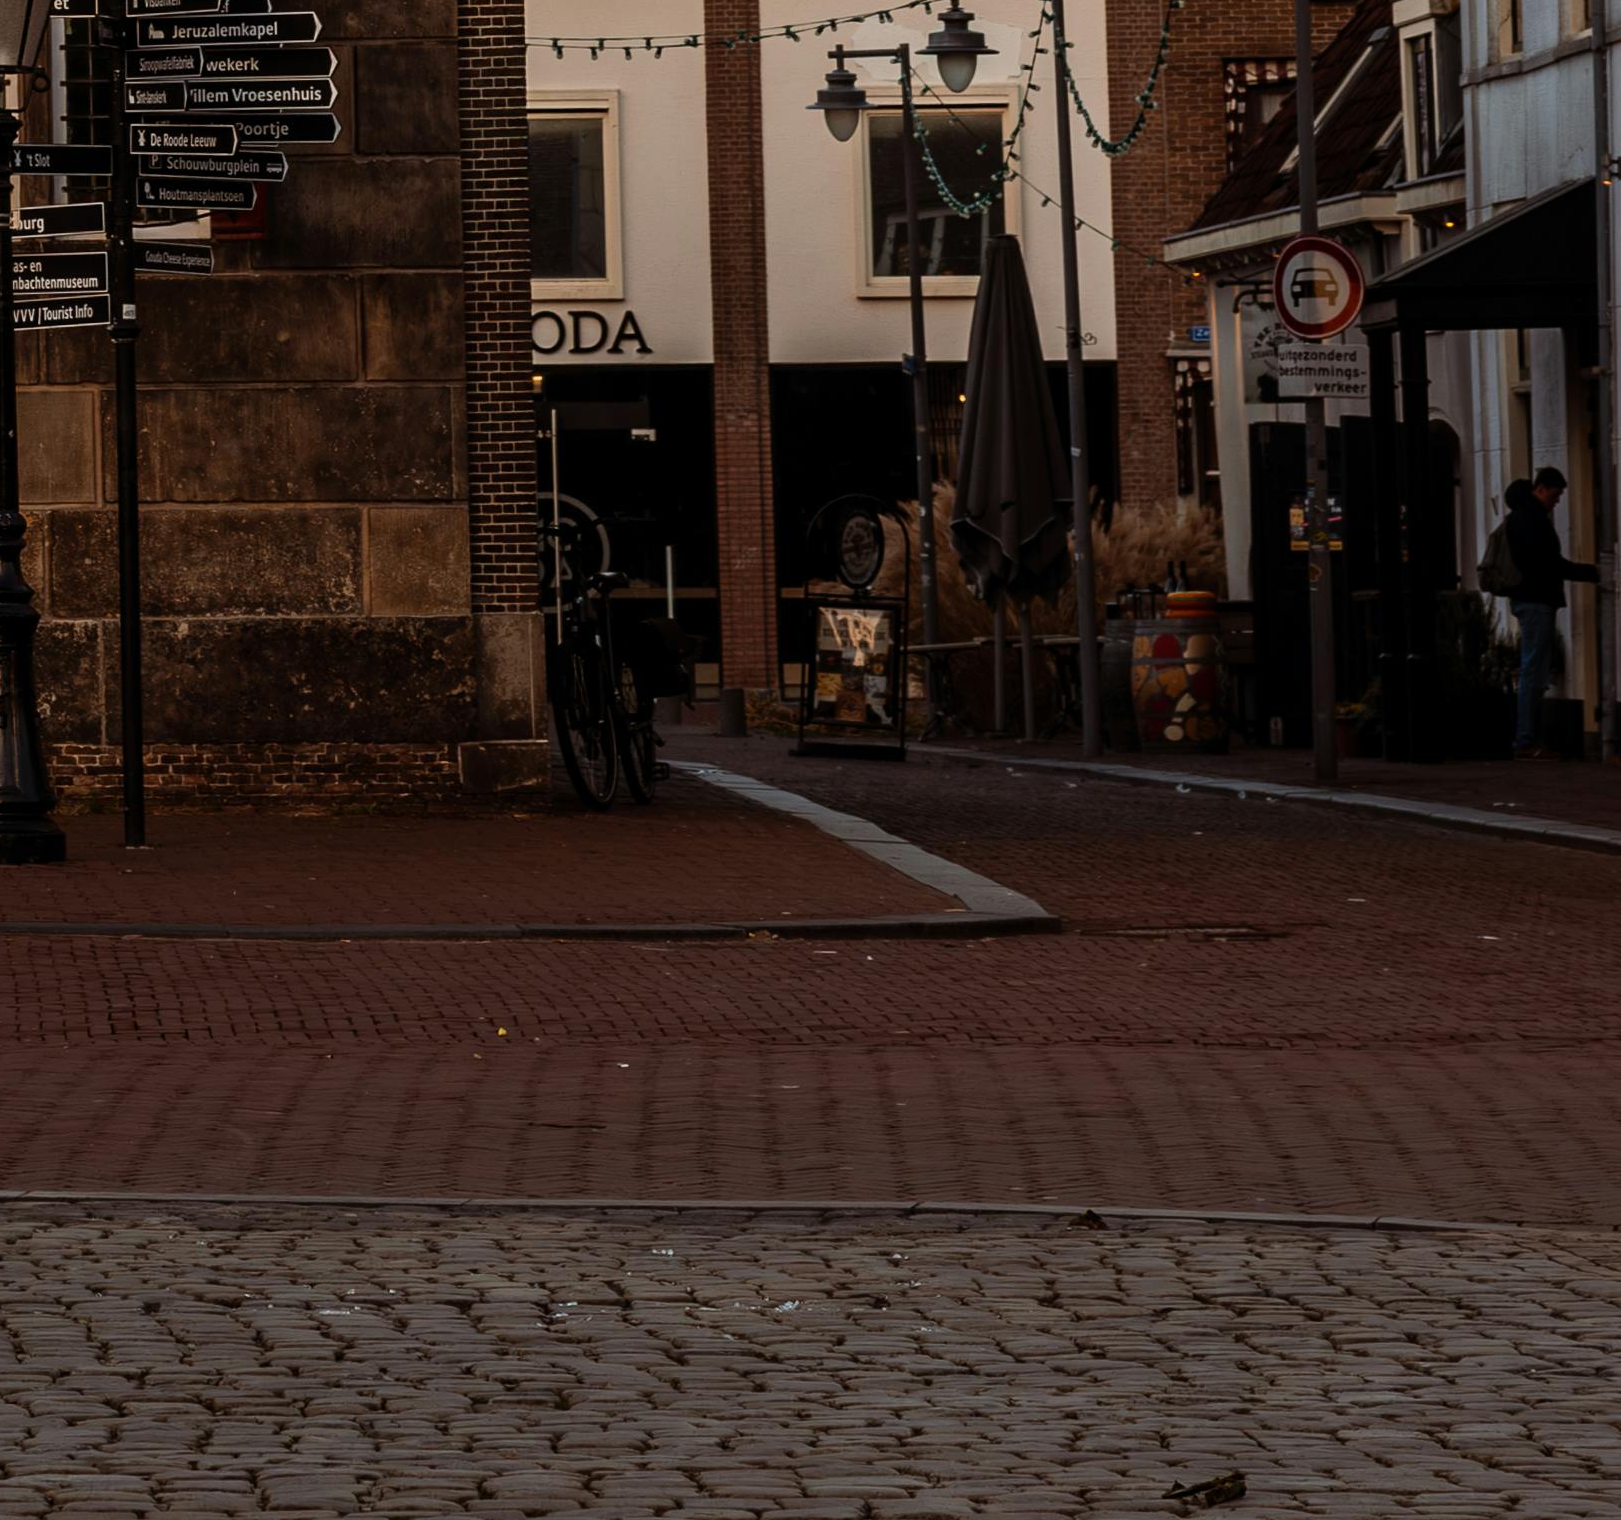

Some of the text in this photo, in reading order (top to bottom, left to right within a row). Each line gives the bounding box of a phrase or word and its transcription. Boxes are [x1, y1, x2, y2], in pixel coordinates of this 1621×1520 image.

[171, 20, 279, 40] Jeruzalemkapel
[205, 56, 260, 72] wekerk
[231, 85, 322, 103] Vroesenhuis
[149, 132, 217, 147] De Roode Leeuw
[34, 152, 52, 168] Slot
[166, 156, 261, 176] Schouwburgplein
[158, 187, 245, 206] Houtmansplantsoen
[12, 260, 43, 273] as- en
[41, 305, 74, 322] Tourist
[75, 303, 94, 319] Info
[532, 310, 653, 354] ODA
[1279, 349, 1358, 365] uitgezonderd
[1279, 364, 1367, 381] bestemmings-
[1314, 381, 1367, 394] verkeer
